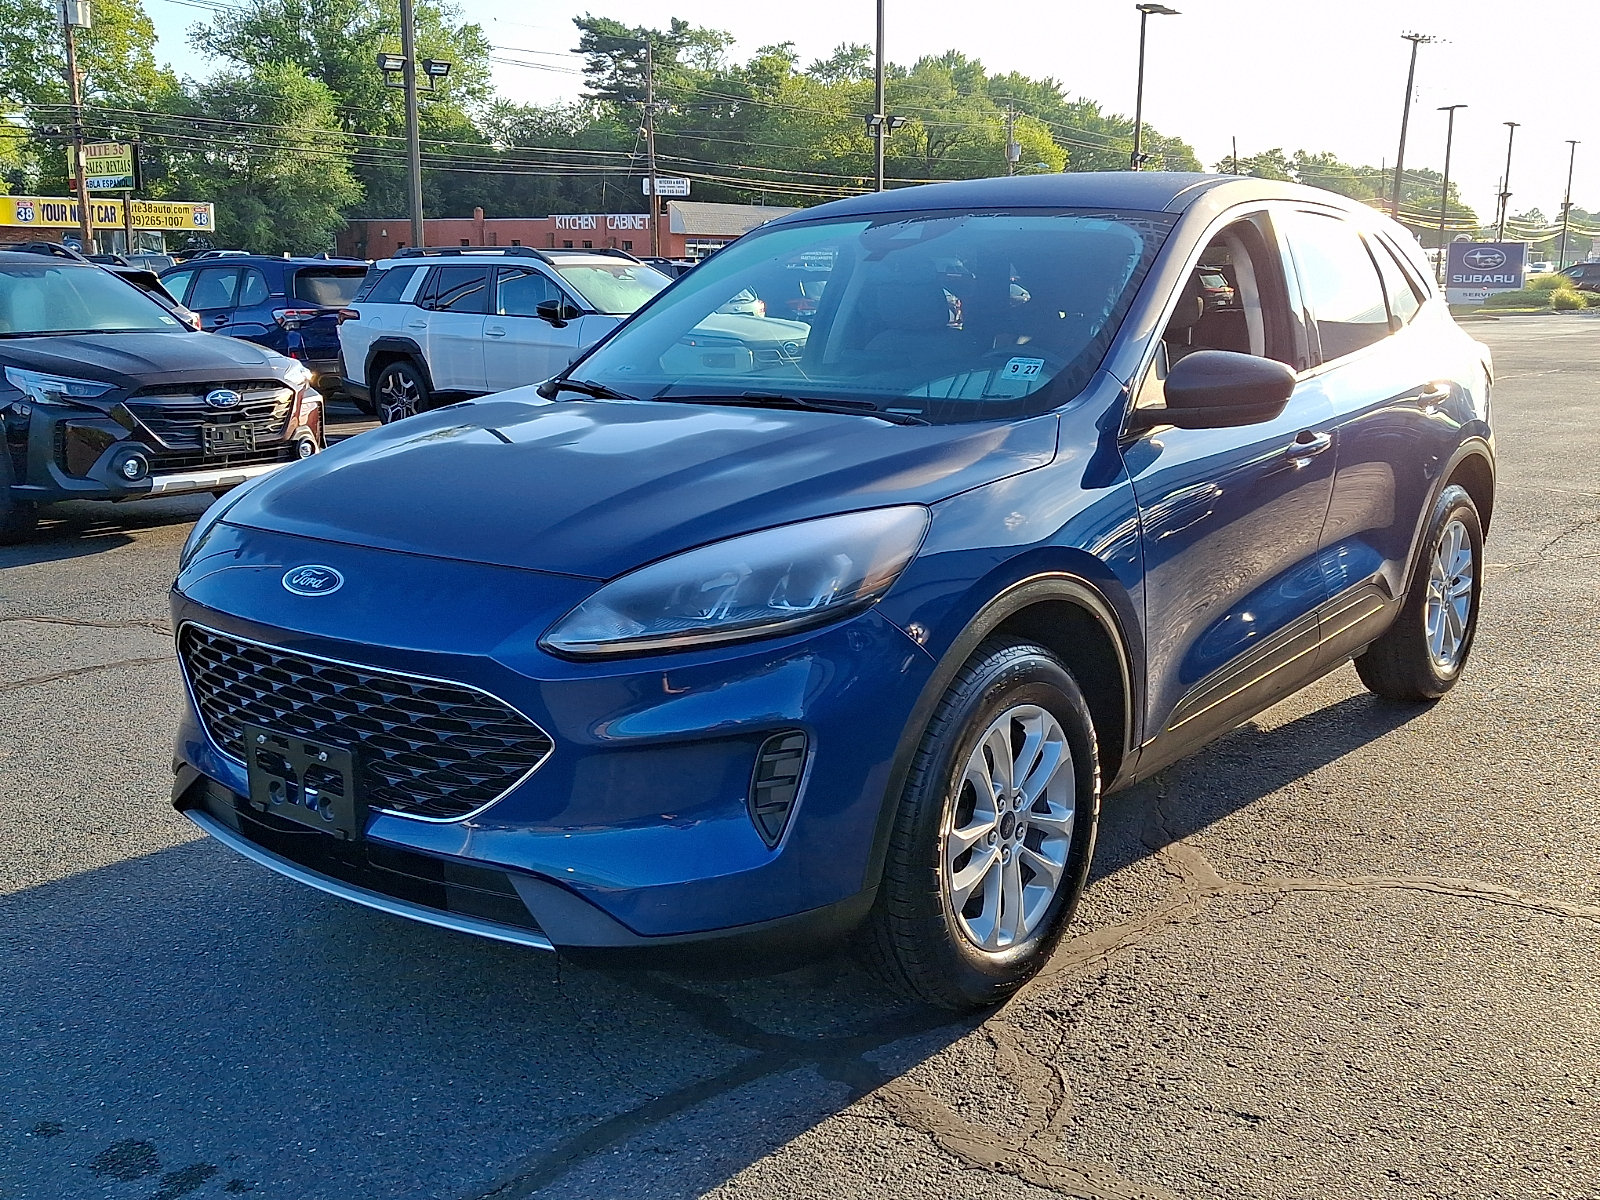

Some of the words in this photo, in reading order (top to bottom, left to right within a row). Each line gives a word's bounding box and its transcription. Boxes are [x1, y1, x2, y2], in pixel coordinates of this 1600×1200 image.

[82, 145, 110, 157] OUTE
[112, 144, 125, 155] 38
[85, 161, 103, 175] SALES
[106, 160, 131, 173] RENTALS
[85, 180, 101, 188] ABLA
[18, 207, 33, 220] 38
[40, 203, 67, 222] YOUR
[69, 204, 96, 223] NT
[97, 205, 117, 223] CAR
[120, 203, 190, 214] rute38auto.com
[121, 214, 184, 227] (09)265-1007
[194, 213, 208, 224] 38
[555, 215, 597, 230] KITCHEN
[606, 215, 650, 230] CABINET
[1452, 274, 1515, 283] SUBARU
[1010, 364, 1020, 373] 9
[1023, 365, 1040, 375] 27
[292, 568, 330, 589] Ford
